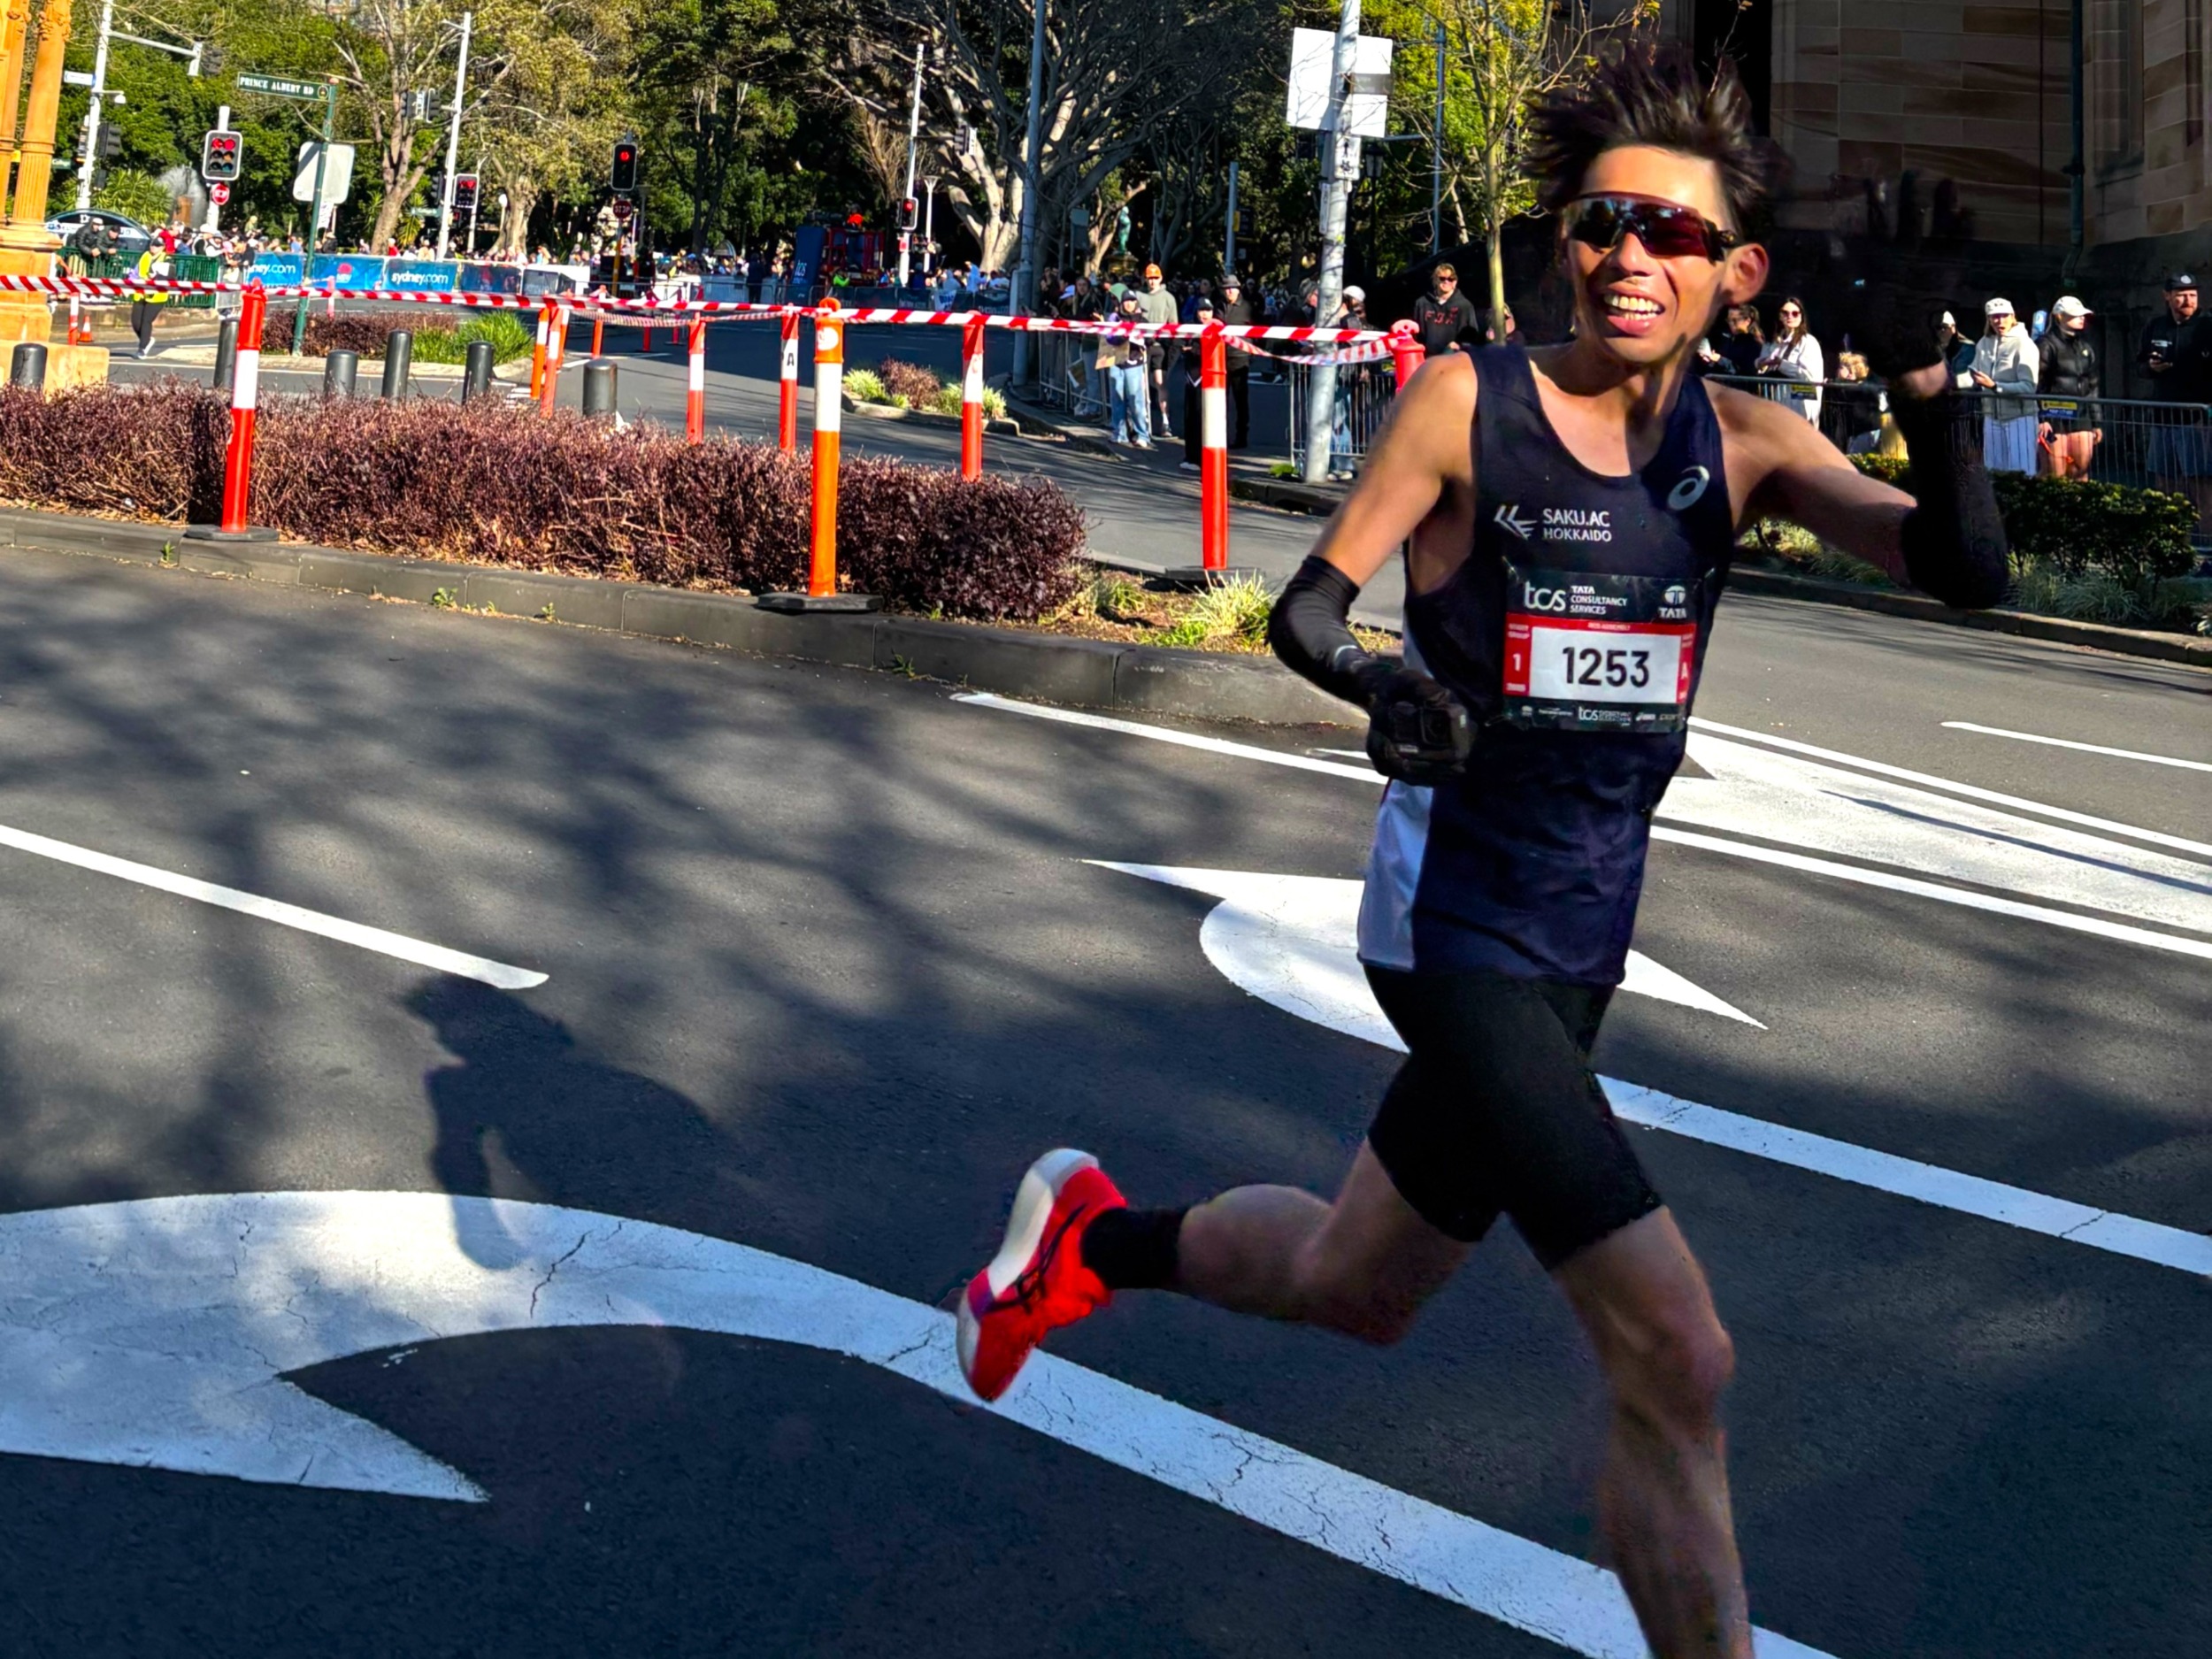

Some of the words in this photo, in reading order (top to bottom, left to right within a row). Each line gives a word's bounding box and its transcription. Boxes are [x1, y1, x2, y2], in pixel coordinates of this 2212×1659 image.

[240, 76, 268, 88] PRINCE
[271, 81, 301, 94] ALBERT
[303, 86, 314, 96] RD
[392, 270, 449, 286] sydney.com
[1542, 508, 1610, 527] SAKU.AC
[1542, 527, 1612, 542] HOKKAIDO
[1524, 580, 1566, 611] tcs
[1570, 585, 1595, 595] TATA
[1570, 594, 1628, 607] CONSULTANCY
[1569, 604, 1607, 615] SERVICES
[1658, 607, 1687, 619] TATA
[1512, 653, 1521, 672] 1
[1562, 646, 1651, 688] 1253
